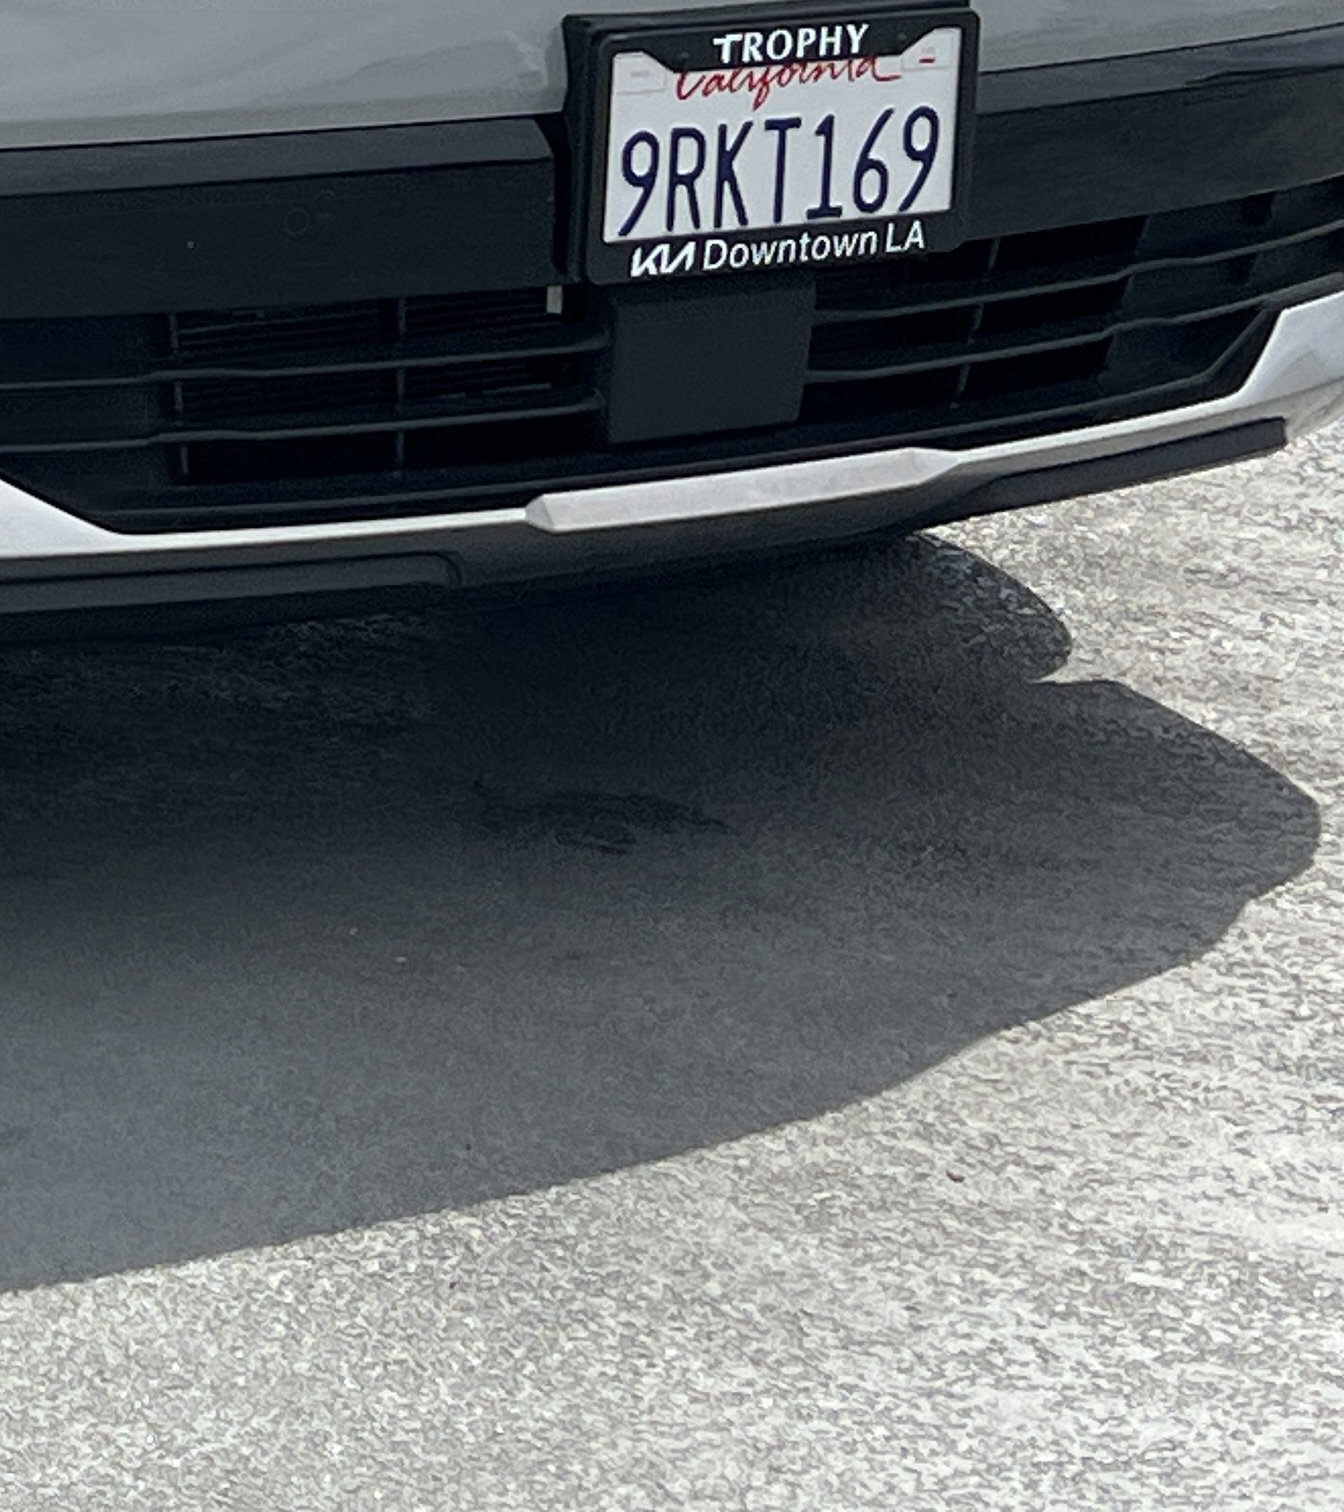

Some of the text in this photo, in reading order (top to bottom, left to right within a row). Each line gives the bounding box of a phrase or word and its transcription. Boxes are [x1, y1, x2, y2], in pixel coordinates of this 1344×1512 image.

[713, 24, 870, 63] TROPHY
[618, 106, 940, 237] 9RKT169
[703, 228, 878, 271] Downtown
[885, 220, 926, 254] LA
